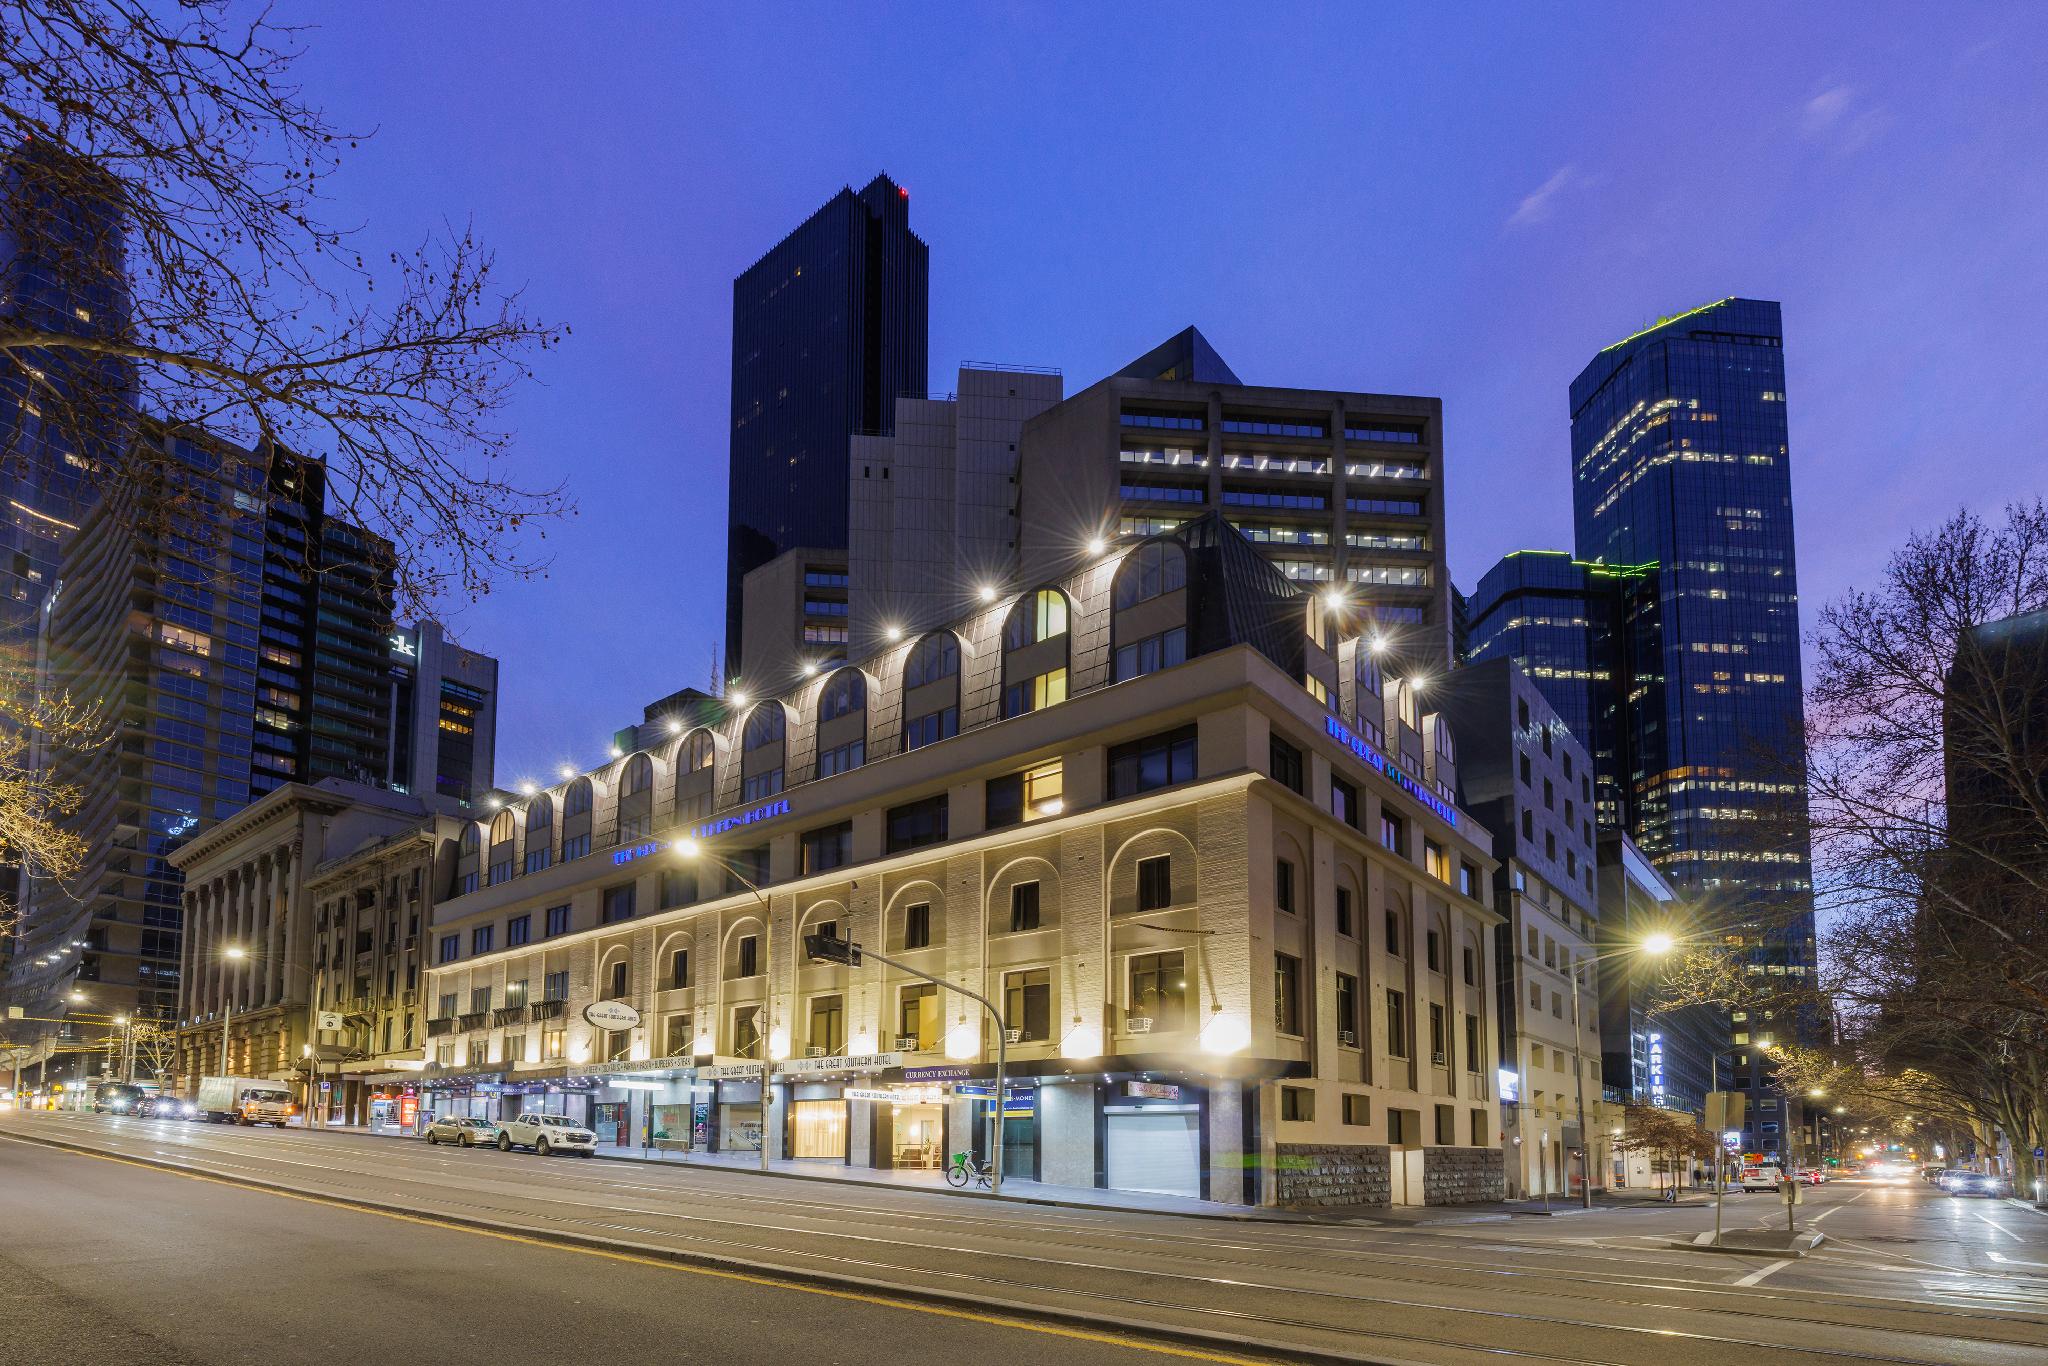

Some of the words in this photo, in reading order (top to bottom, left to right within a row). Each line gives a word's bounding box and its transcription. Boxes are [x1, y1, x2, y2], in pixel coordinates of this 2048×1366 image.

[1325, 716, 1348, 745] THE
[1350, 735, 1383, 773] GREAT
[743, 799, 791, 824] HOTEL
[720, 1067, 729, 1076] THE
[730, 1065, 745, 1076] GREAT
[814, 1059, 824, 1070] THE
[825, 1058, 843, 1069] GREAT
[844, 1056, 872, 1068] SOUTHERN
[873, 1054, 892, 1066] HOTEL
[1650, 1033, 1669, 1105] PARKING
[905, 1070, 937, 1079] CURRENCY
[937, 1068, 970, 1078] EXCHANGE
